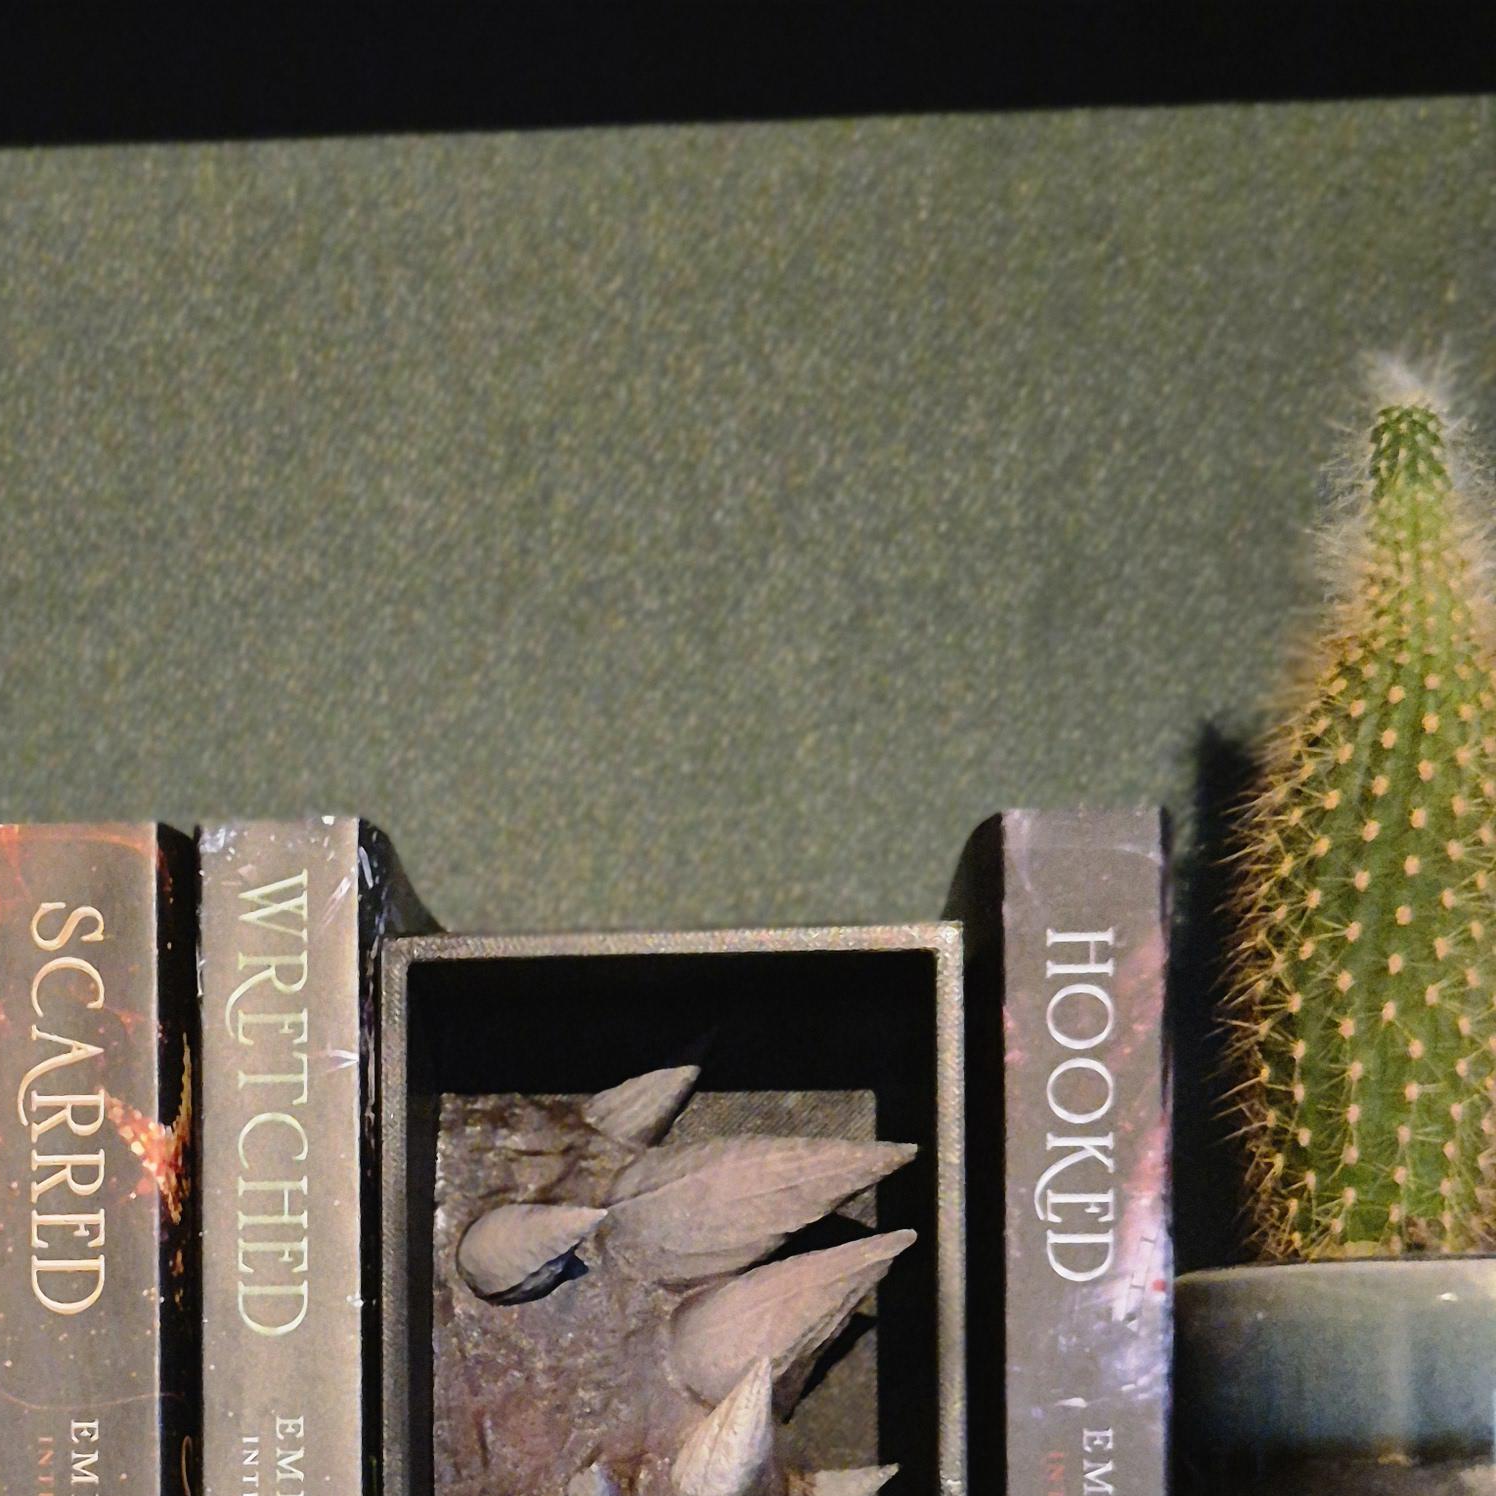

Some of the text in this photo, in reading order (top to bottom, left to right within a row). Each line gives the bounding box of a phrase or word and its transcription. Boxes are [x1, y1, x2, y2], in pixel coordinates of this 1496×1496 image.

[17, 902, 106, 1314] SCARRED
[225, 868, 308, 1336] WRETCHED
[1034, 927, 1115, 1283] HOOKED
